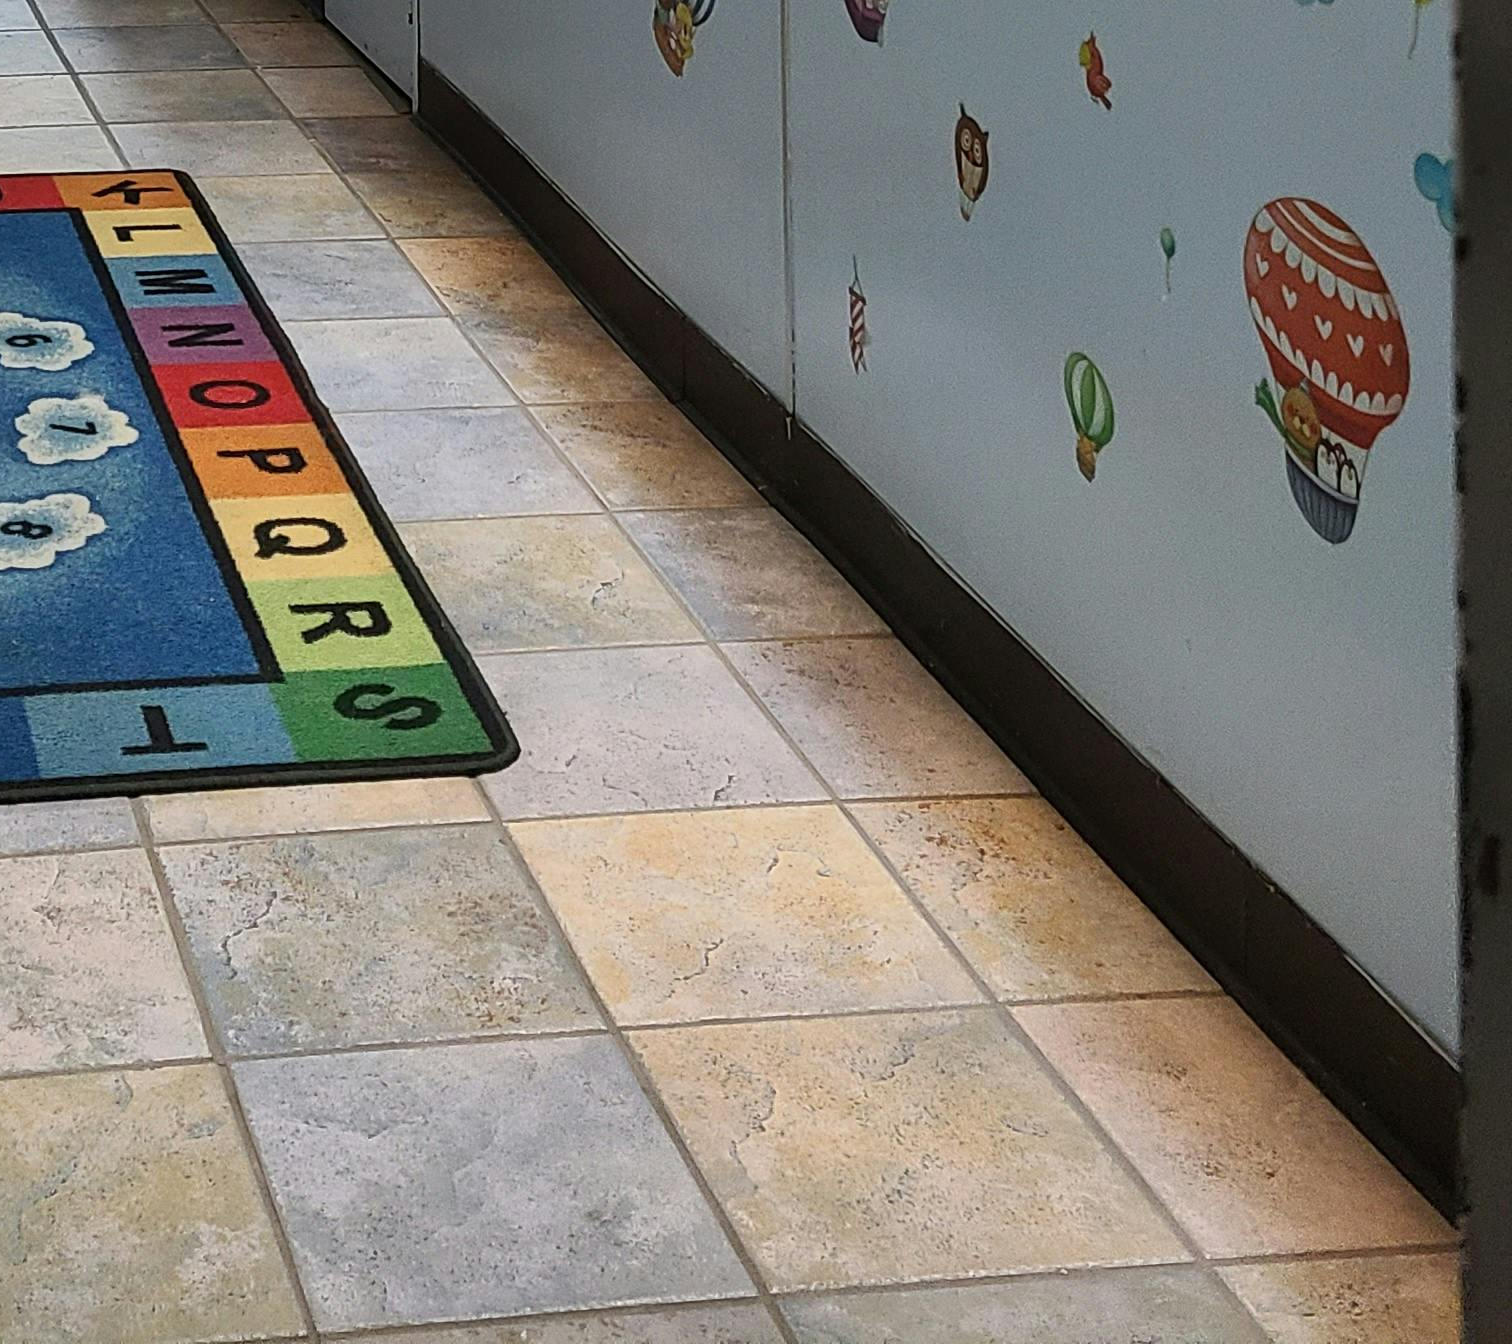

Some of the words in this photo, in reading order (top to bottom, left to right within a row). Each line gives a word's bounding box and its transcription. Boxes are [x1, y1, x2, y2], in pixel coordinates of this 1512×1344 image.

[90, 179, 173, 205] K
[112, 223, 182, 242] L
[134, 268, 216, 296] M
[6, 333, 53, 349] 6
[159, 322, 244, 350] N
[189, 379, 271, 410] O
[50, 420, 98, 436] 7
[216, 447, 308, 475] P
[0, 520, 53, 540] 8
[252, 517, 348, 560] Q
[287, 600, 393, 645] R
[332, 682, 443, 732] S
[120, 704, 209, 757] T
